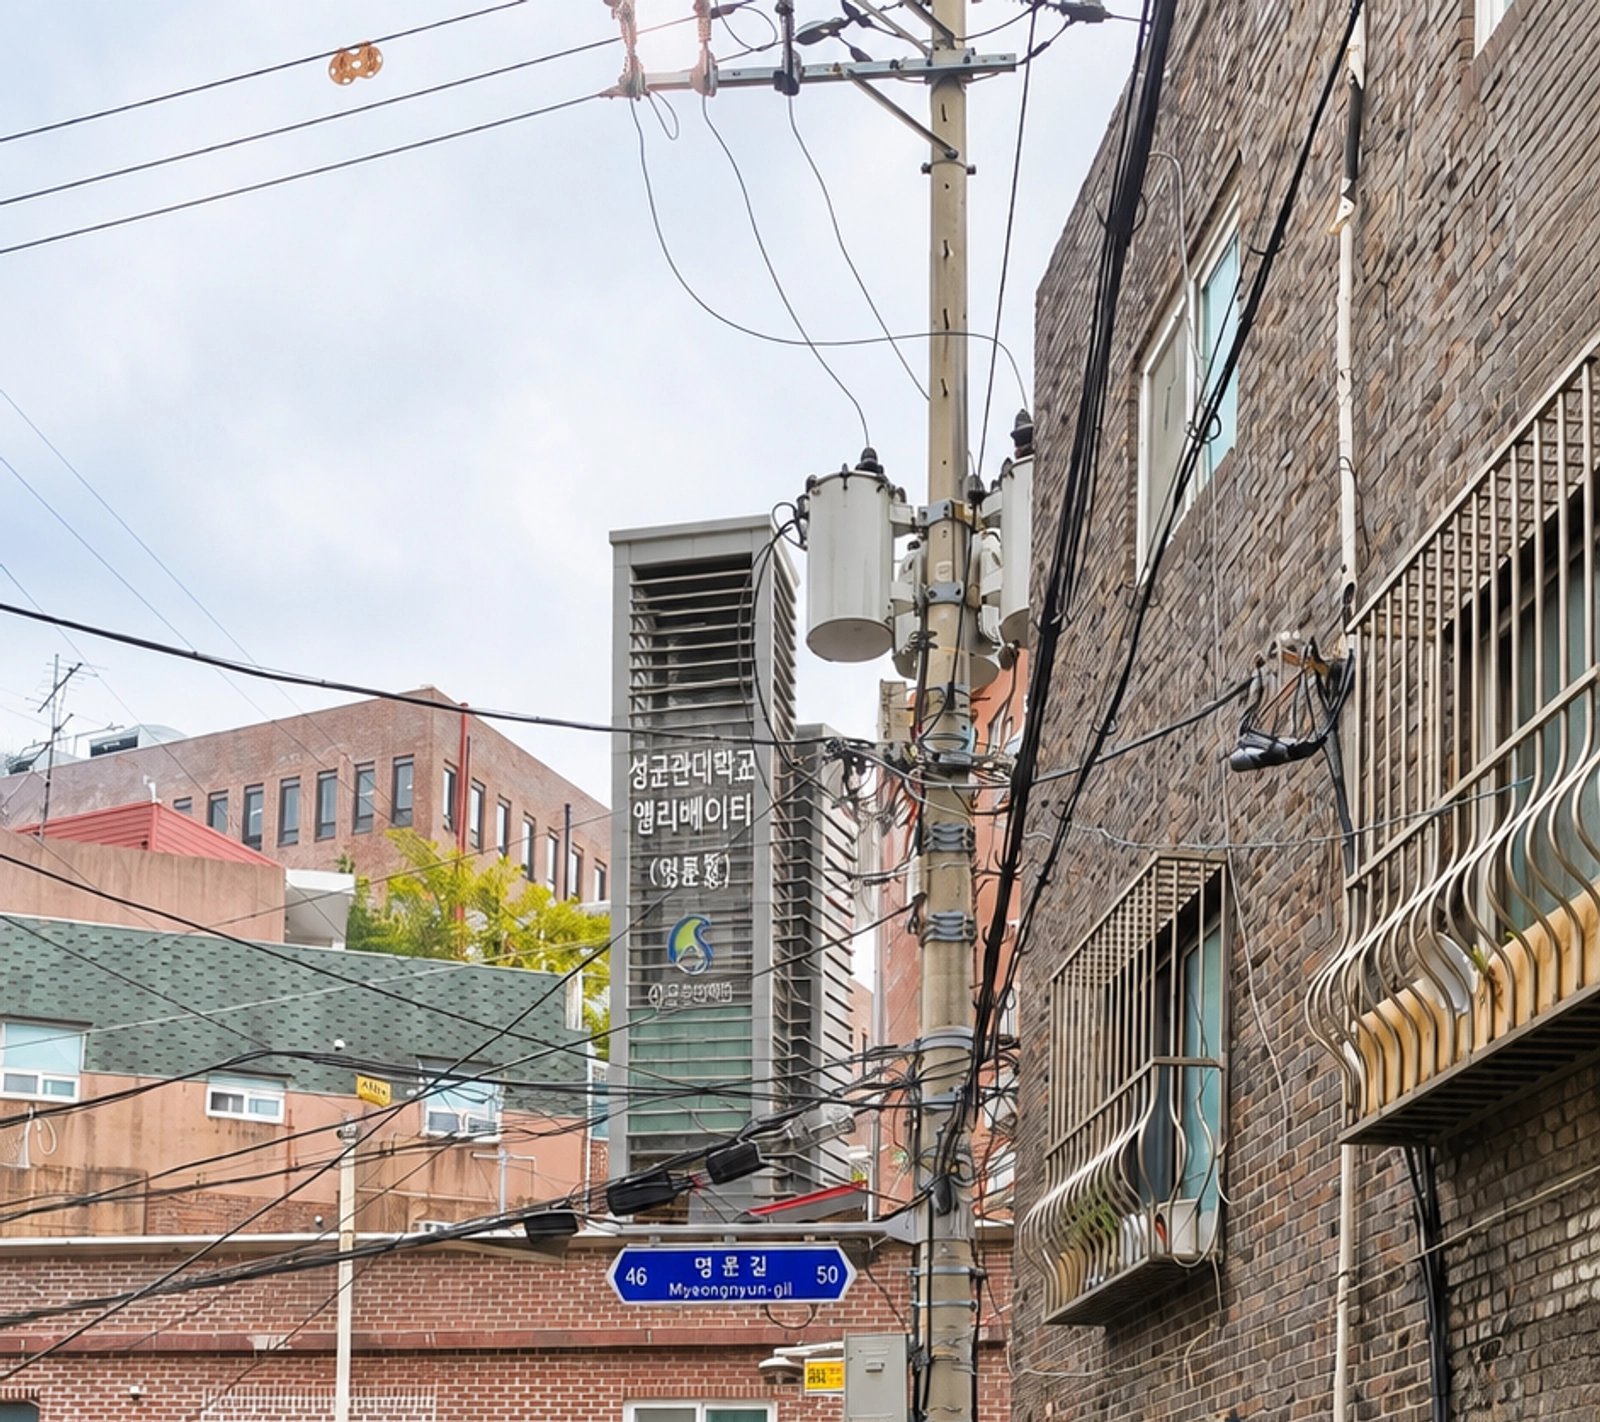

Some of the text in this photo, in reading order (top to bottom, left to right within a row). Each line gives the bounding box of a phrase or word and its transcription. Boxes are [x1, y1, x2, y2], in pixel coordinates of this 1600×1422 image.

[625, 1267, 647, 1286] 46
[816, 1266, 838, 1284] 50
[669, 1281, 793, 1299] Myeongnyun-gil
